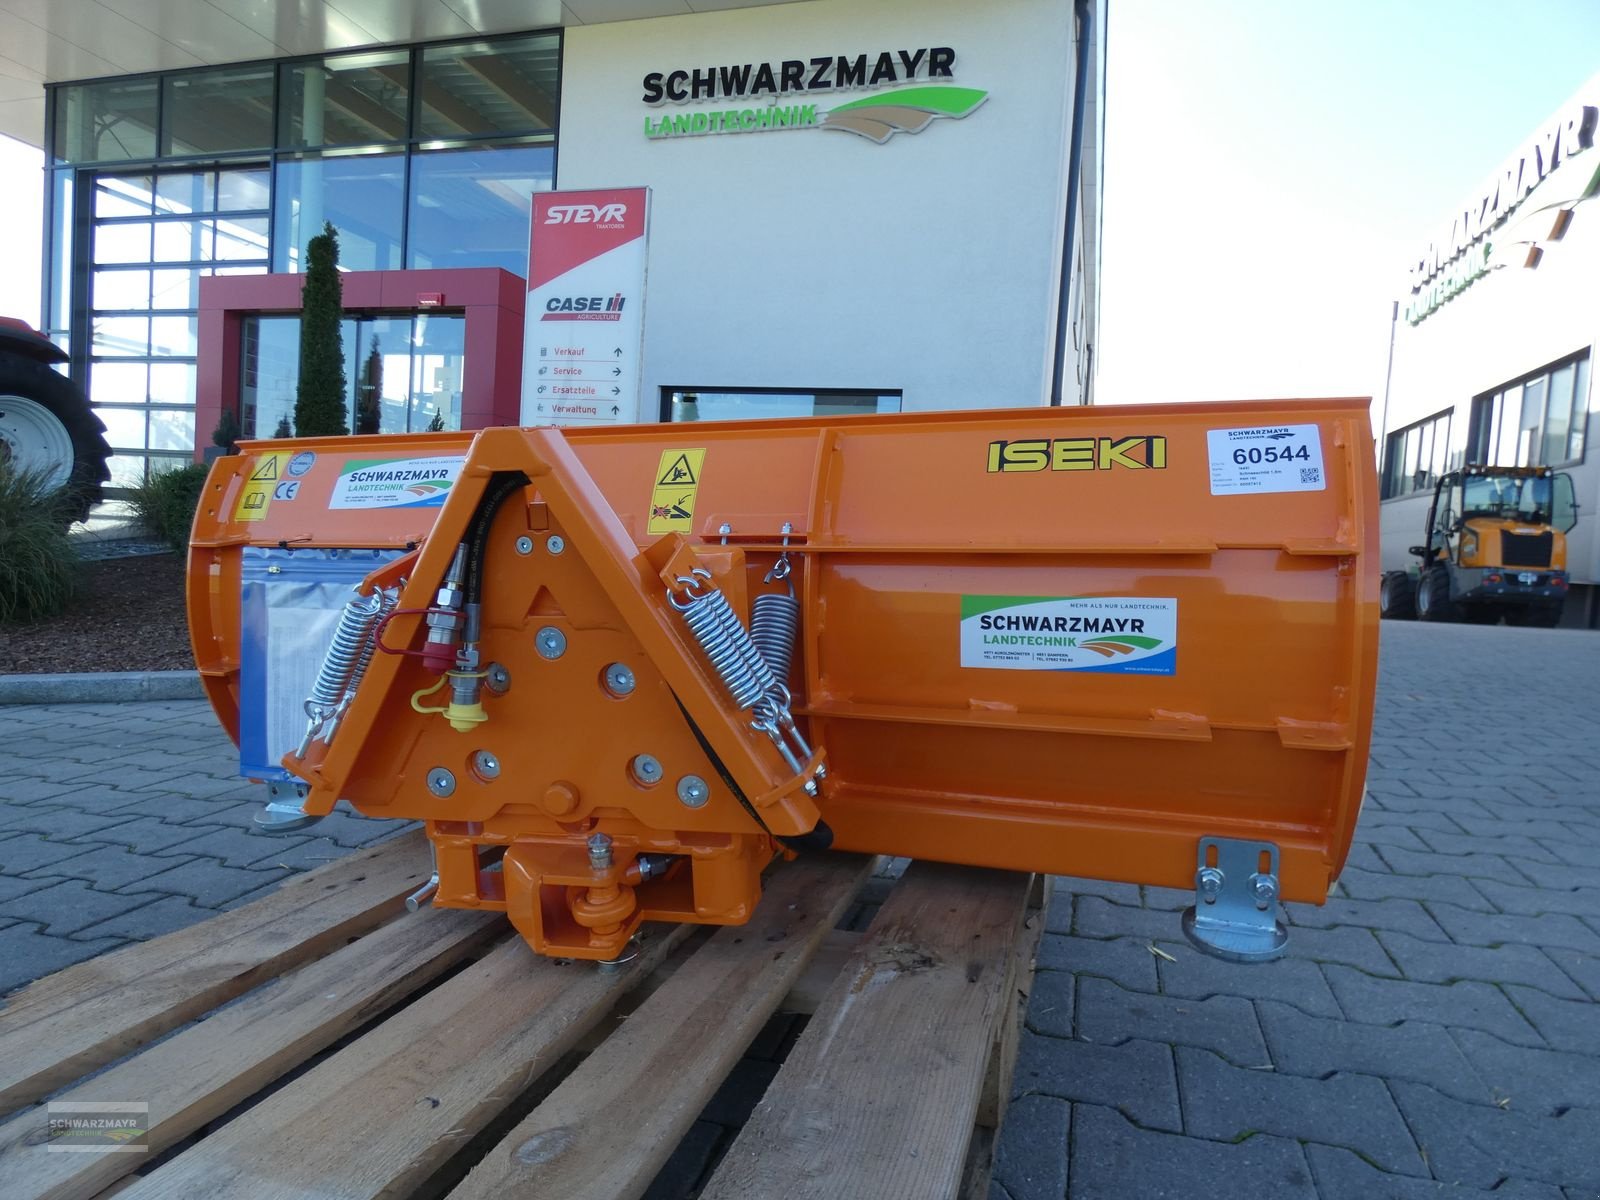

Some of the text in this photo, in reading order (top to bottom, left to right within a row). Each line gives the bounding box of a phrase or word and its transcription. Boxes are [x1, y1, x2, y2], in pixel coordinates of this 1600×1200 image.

[642, 46, 957, 103] SCHWARZMAYR
[644, 103, 818, 138] LANDTECHNIK
[544, 203, 627, 225] STEYR
[546, 297, 602, 312] CASE
[577, 313, 619, 321] AGRICULTURE
[554, 347, 585, 356] Verkauf
[553, 367, 582, 376] Service
[552, 386, 596, 395] Ersatzteile
[552, 404, 597, 415] Verwaltung
[1228, 428, 1289, 437] SCHWARZMAYR
[987, 436, 1167, 473] ISEKI
[1233, 444, 1311, 465] 60544
[349, 469, 449, 483] SCHWARZMAYR
[275, 482, 296, 499] CE
[347, 483, 405, 492] LANDTECHNIK
[980, 615, 1145, 633] SCHWARZMAYR
[983, 634, 1077, 647] LANDTECHNIK
